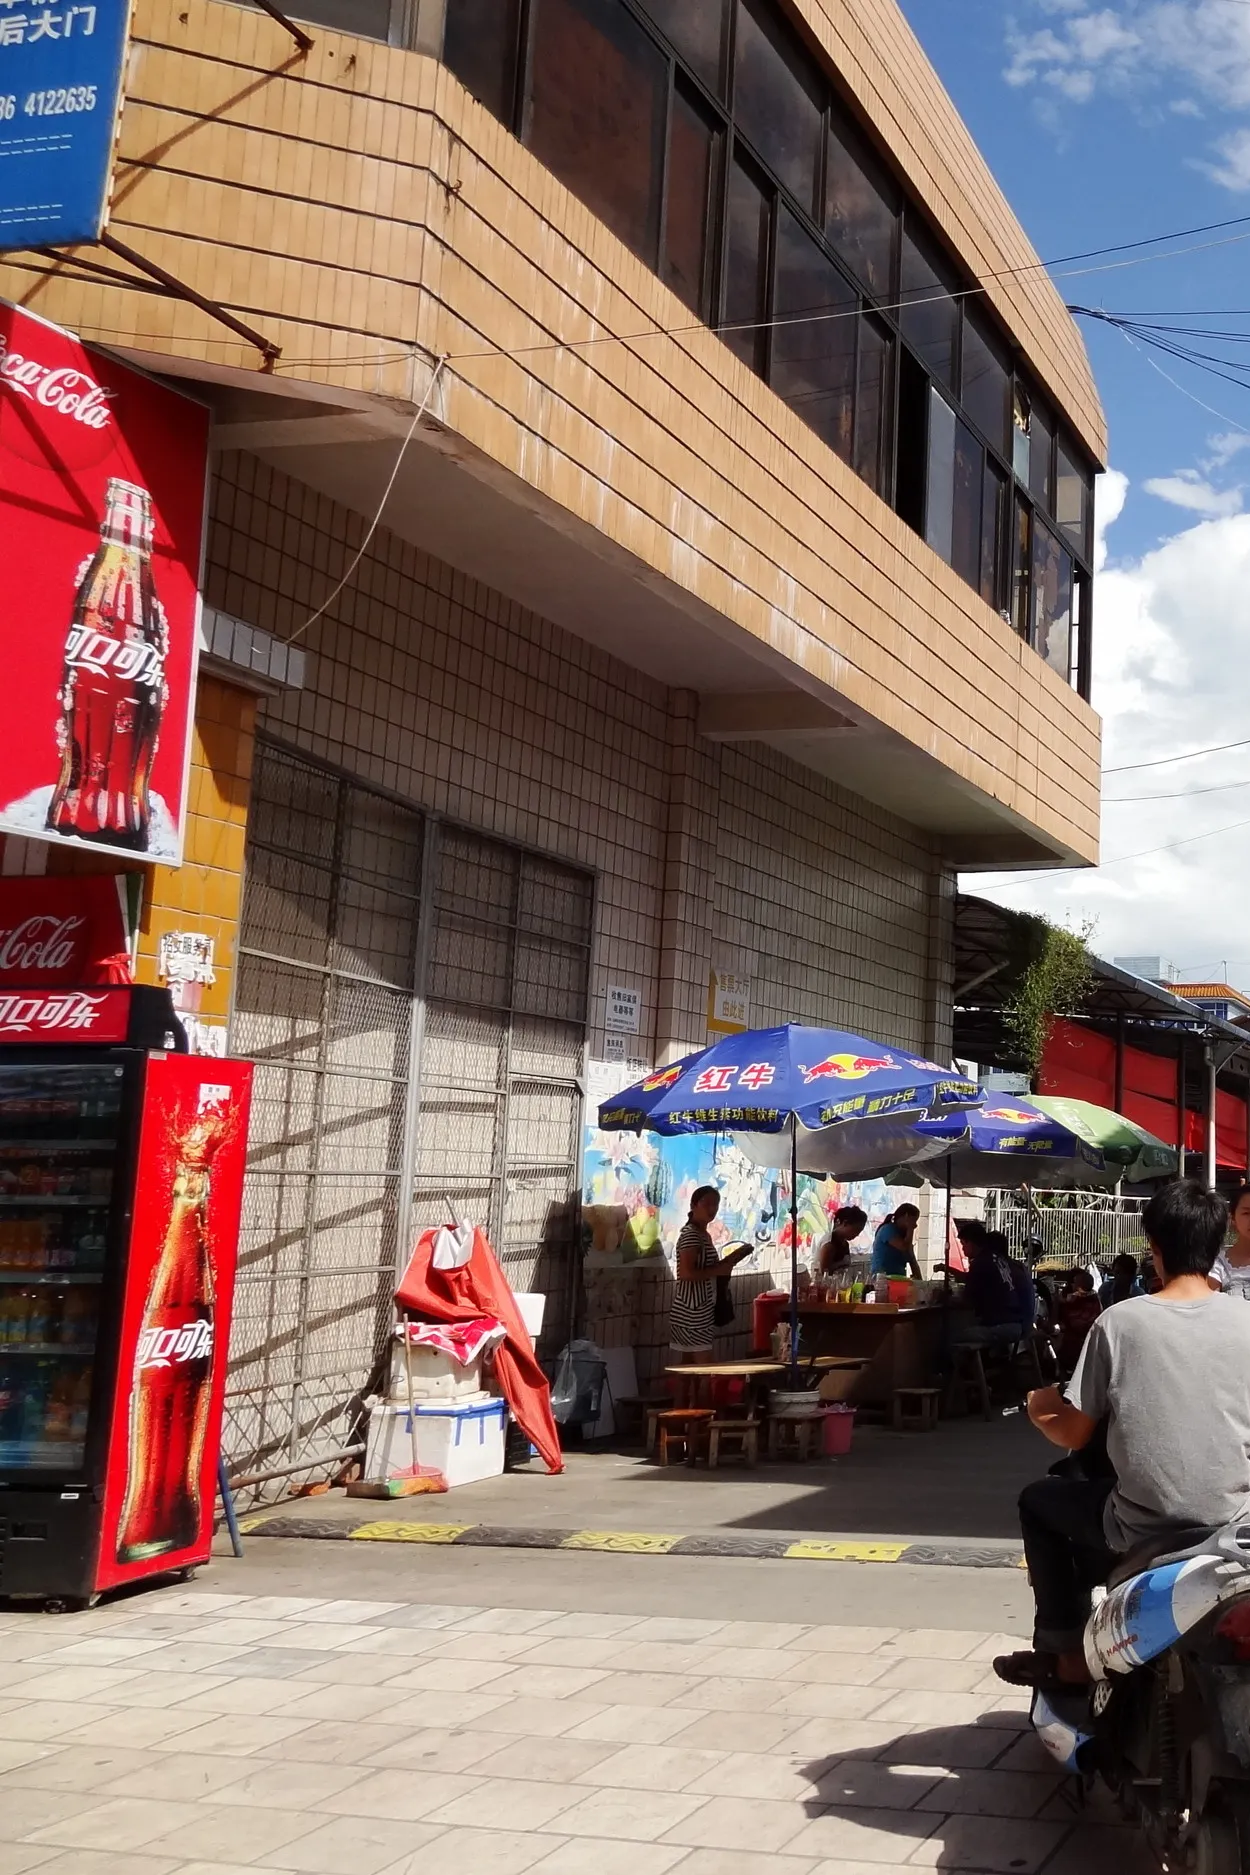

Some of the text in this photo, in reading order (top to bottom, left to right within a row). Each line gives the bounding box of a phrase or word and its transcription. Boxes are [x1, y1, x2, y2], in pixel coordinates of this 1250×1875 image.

[0, 6, 97, 46] 后大门
[24, 86, 98, 117] 4122635
[64, 623, 164, 686] 可口可乐
[0, 915, 87, 970] -Cola
[720, 974, 750, 997] 售票大厅
[0, 992, 110, 1032] 可口可乐
[693, 1062, 775, 1093] 红牛
[668, 1107, 778, 1125] 红牛维生素功能饮料
[138, 1319, 213, 1361] 可口可乐
